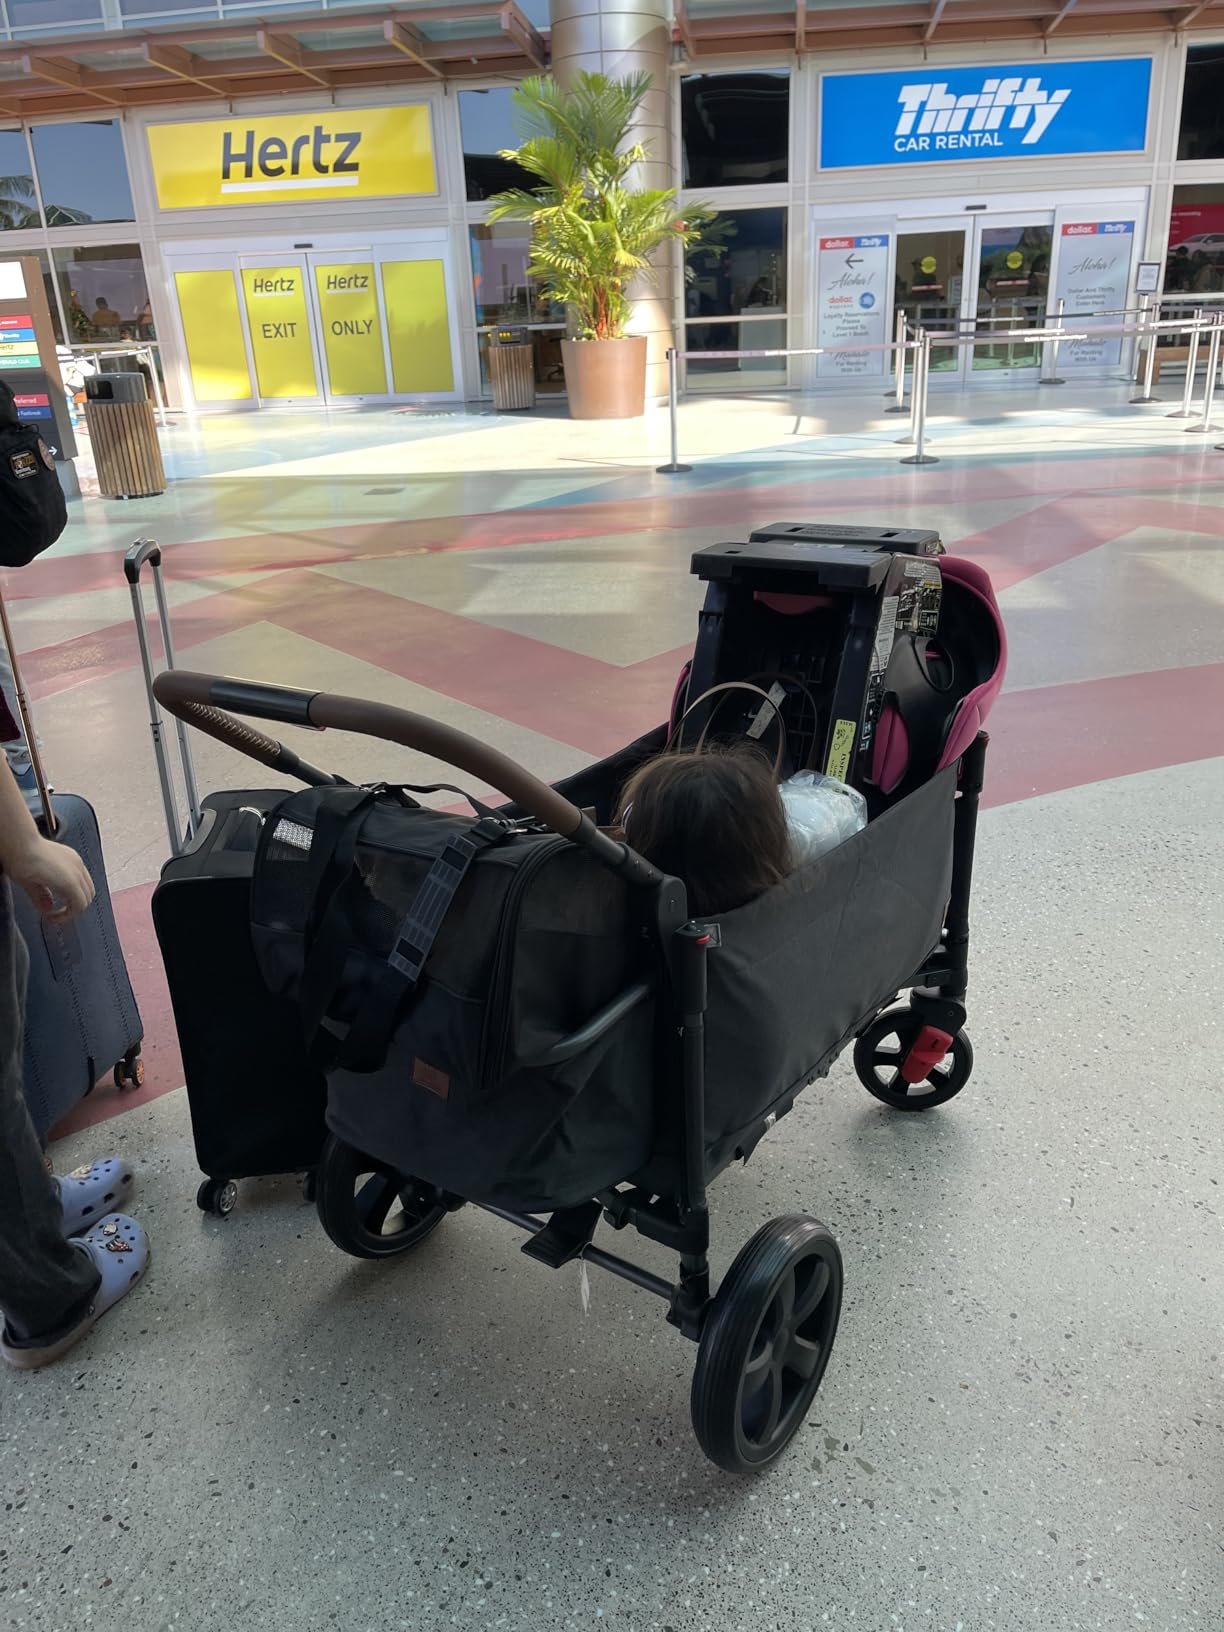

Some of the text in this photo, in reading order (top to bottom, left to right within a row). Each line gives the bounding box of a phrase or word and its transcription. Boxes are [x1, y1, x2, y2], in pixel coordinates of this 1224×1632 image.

[894, 77, 1072, 144] Thrifty
[894, 133, 1003, 152] CAR RENTAL
[222, 125, 362, 180] Hertz
[254, 277, 295, 293] Hertz
[327, 273, 369, 289] Hertz
[262, 320, 373, 339] EXIT ONLY
